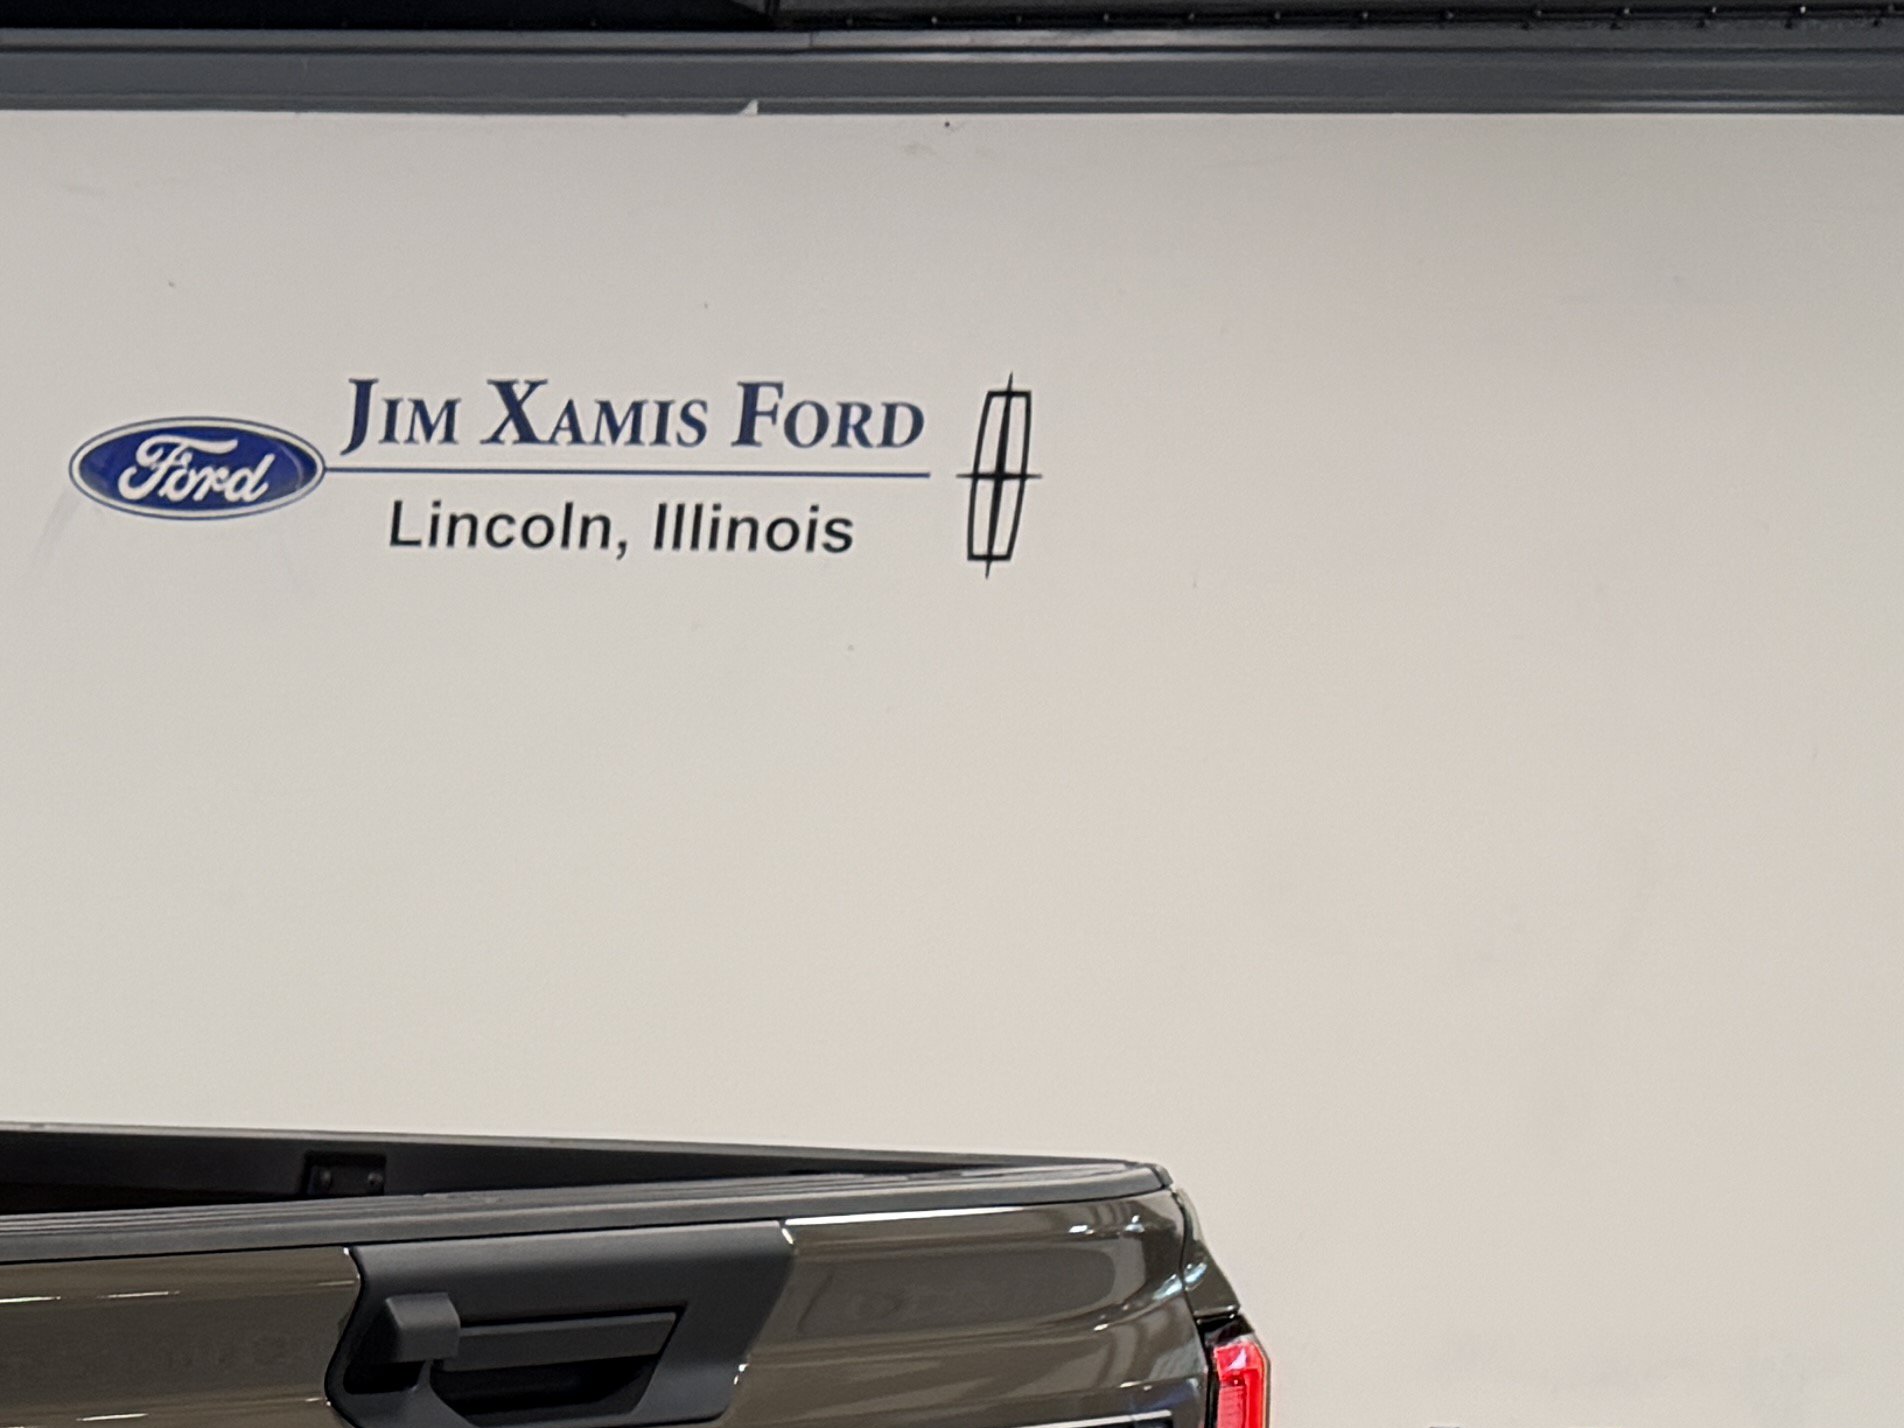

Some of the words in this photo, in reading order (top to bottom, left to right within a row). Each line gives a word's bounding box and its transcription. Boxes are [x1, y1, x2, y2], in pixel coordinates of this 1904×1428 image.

[340, 378, 459, 457] JIM
[479, 379, 708, 449] XAMIS
[732, 381, 925, 450] FORD
[118, 434, 270, 506] Ford
[390, 500, 629, 560] Lincoln,
[653, 503, 854, 556] Illinois
